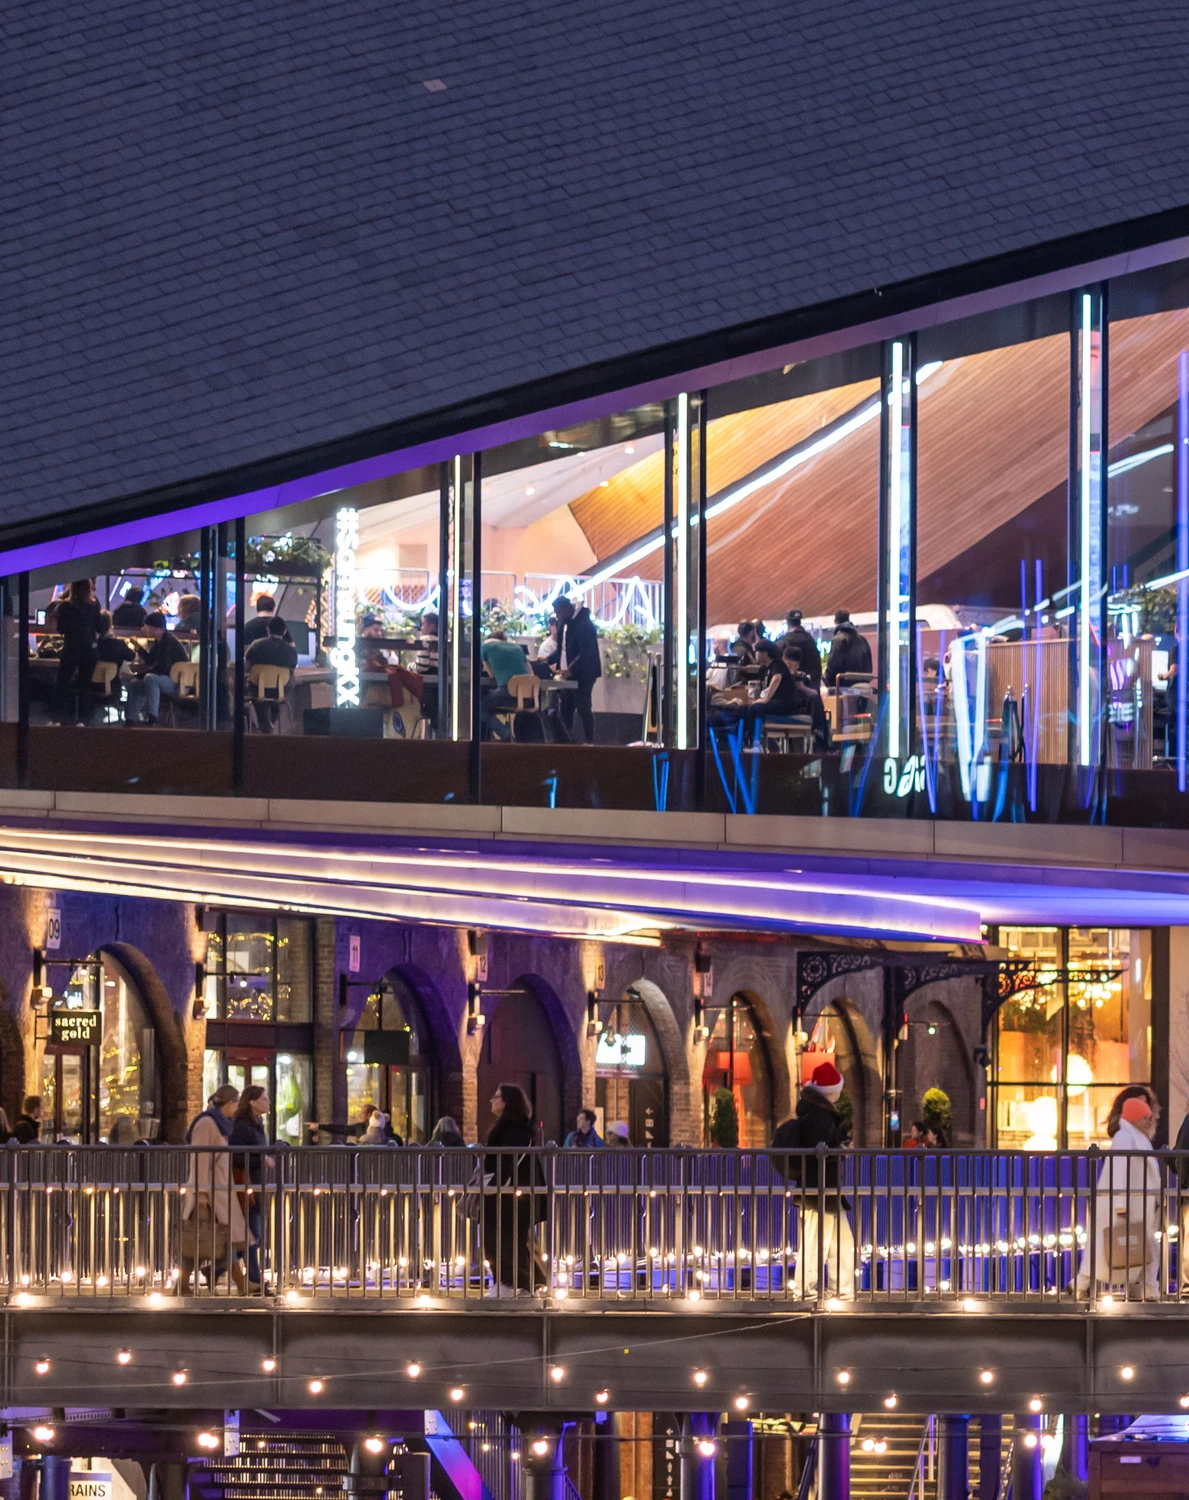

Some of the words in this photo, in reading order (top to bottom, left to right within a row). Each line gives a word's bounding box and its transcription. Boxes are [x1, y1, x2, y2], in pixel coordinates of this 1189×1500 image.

[48, 918, 60, 939] 09
[54, 1014, 97, 1027] sacred
[61, 1027, 91, 1042] gold
